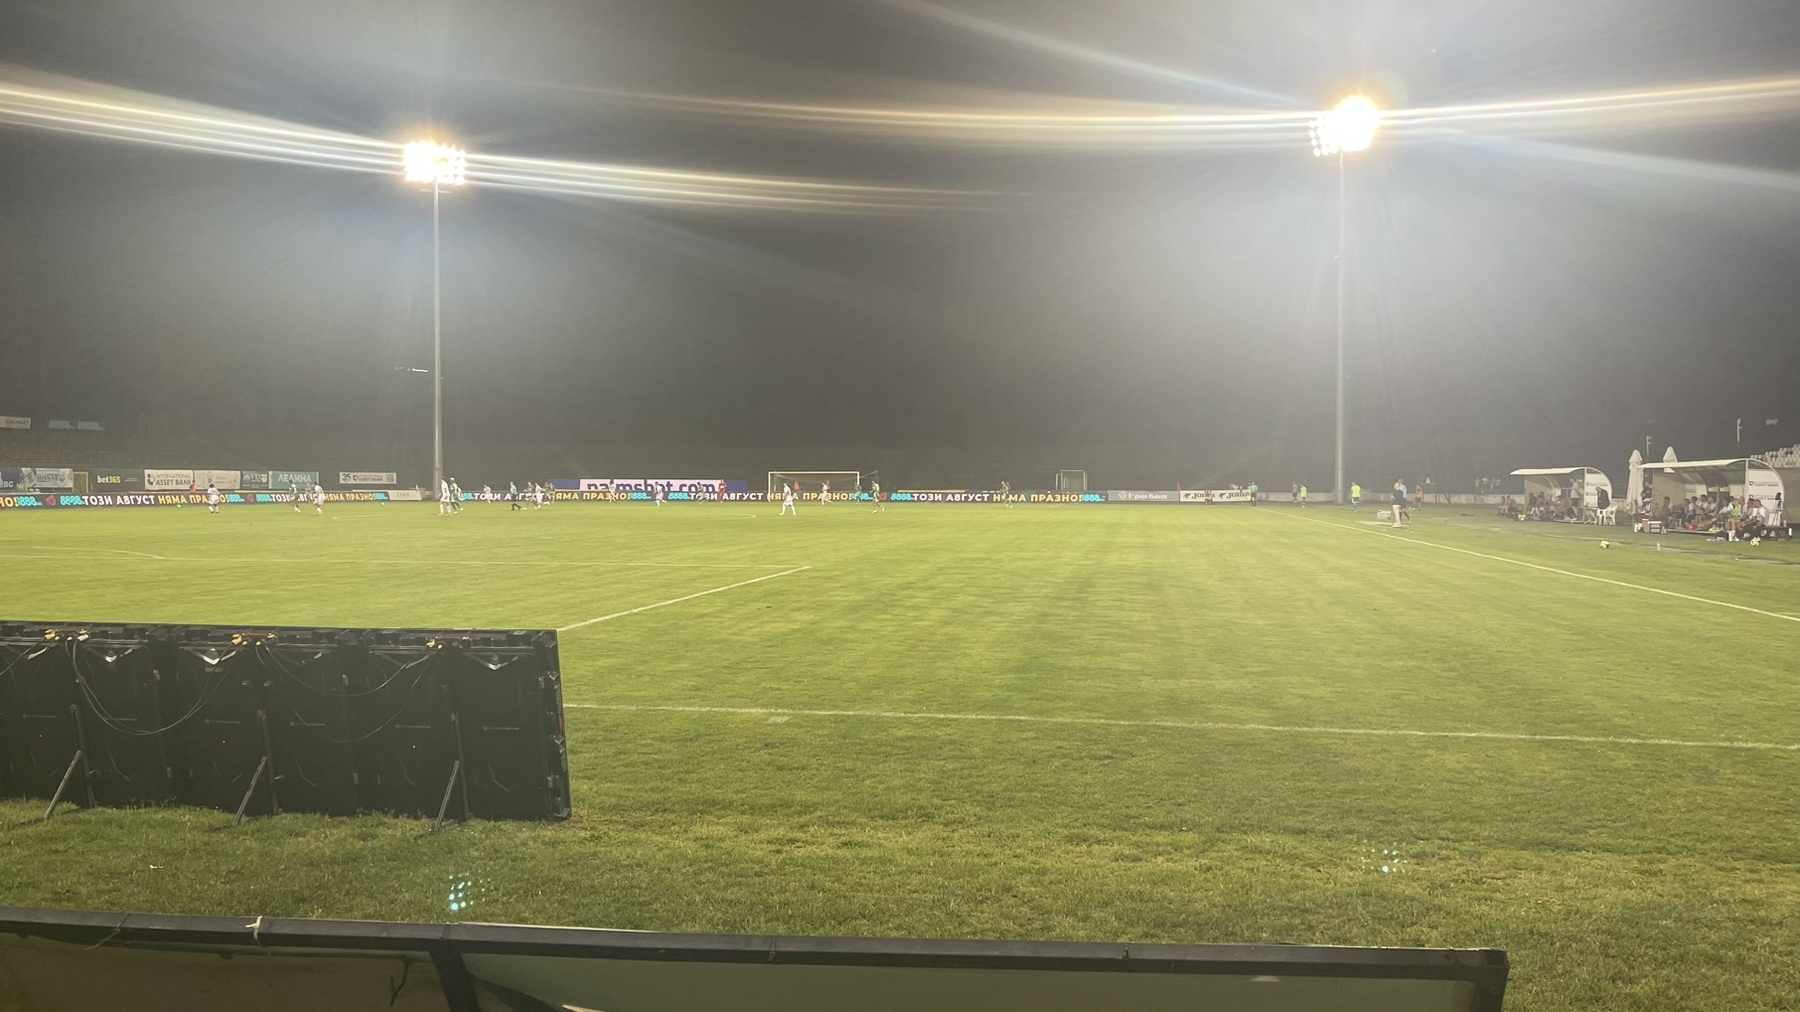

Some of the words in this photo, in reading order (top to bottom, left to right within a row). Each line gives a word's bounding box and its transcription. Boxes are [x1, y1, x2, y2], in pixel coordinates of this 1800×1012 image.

[97, 475, 121, 483] bet365
[82, 495, 113, 506] ТОЗИ
[157, 494, 188, 505] НЯМА
[189, 494, 229, 504] ПРАО!
[912, 493, 942, 501] ТОЗИ
[993, 493, 1026, 502] НМА
[1030, 493, 1082, 502] ПРАЗНО!
